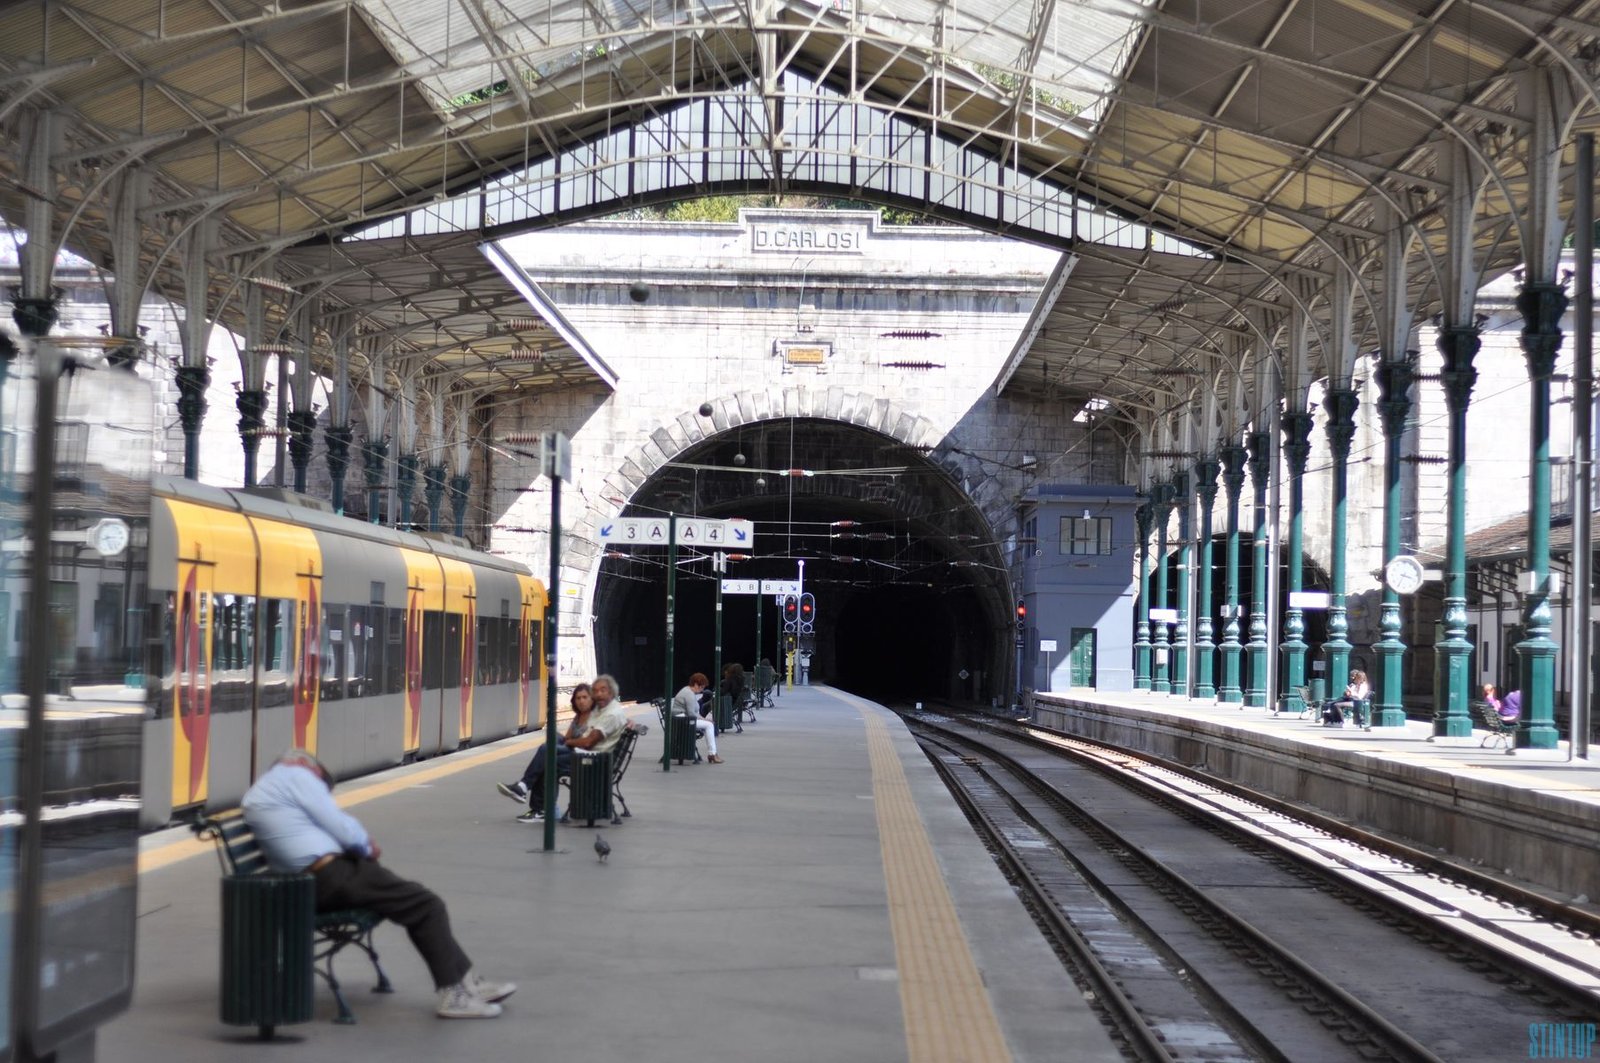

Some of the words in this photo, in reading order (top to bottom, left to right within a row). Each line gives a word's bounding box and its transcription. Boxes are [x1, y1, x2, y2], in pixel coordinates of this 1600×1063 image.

[627, 526, 636, 539] 3
[651, 526, 663, 538] A
[684, 526, 695, 538] A
[709, 528, 718, 541] 4
